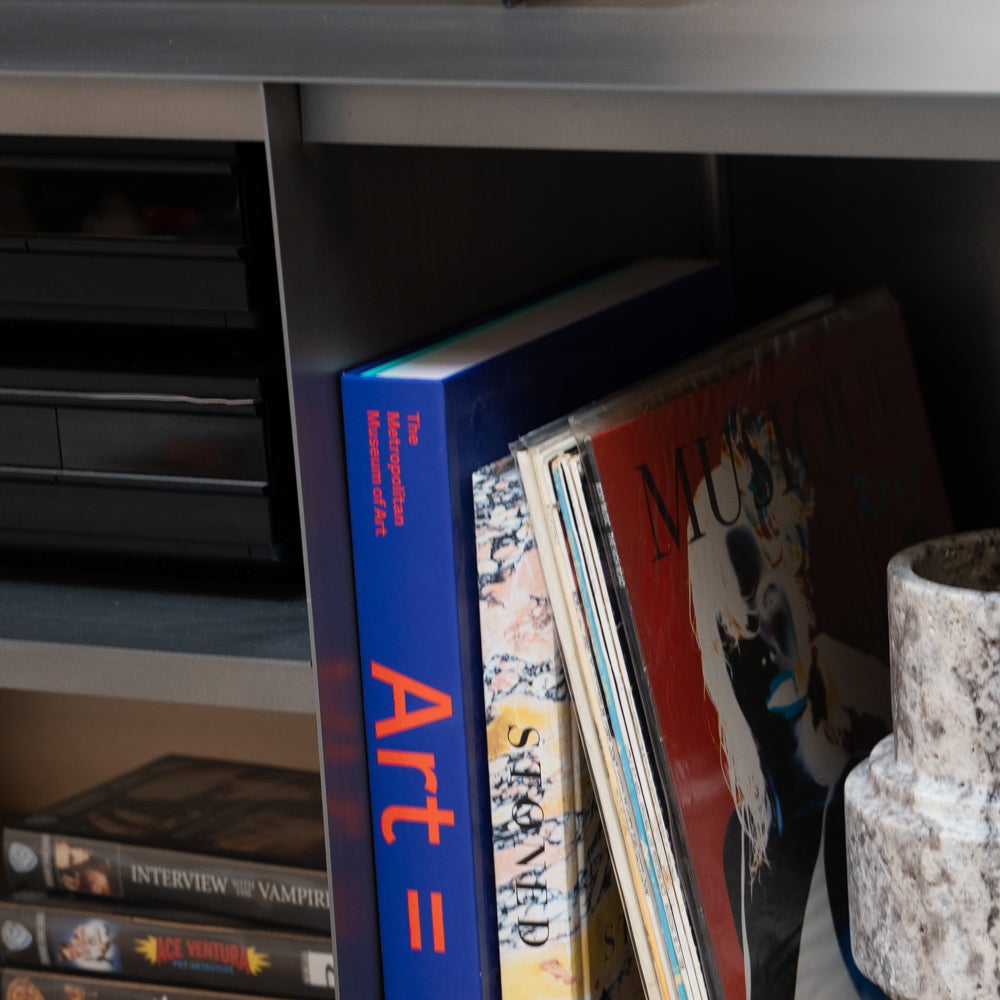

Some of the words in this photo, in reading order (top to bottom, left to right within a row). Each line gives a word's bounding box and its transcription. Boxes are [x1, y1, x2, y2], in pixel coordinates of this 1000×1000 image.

[367, 410, 382, 484] Museum
[407, 412, 420, 446] The
[387, 411, 405, 527] Metropolitan
[372, 488, 386, 507] of
[375, 507, 388, 537] Art
[370, 660, 454, 845] Art
[507, 724, 550, 948] STONED
[130, 864, 228, 895] INTERVIEW
[157, 936, 183, 967] ACE
[186, 939, 251, 976] VENTURA
